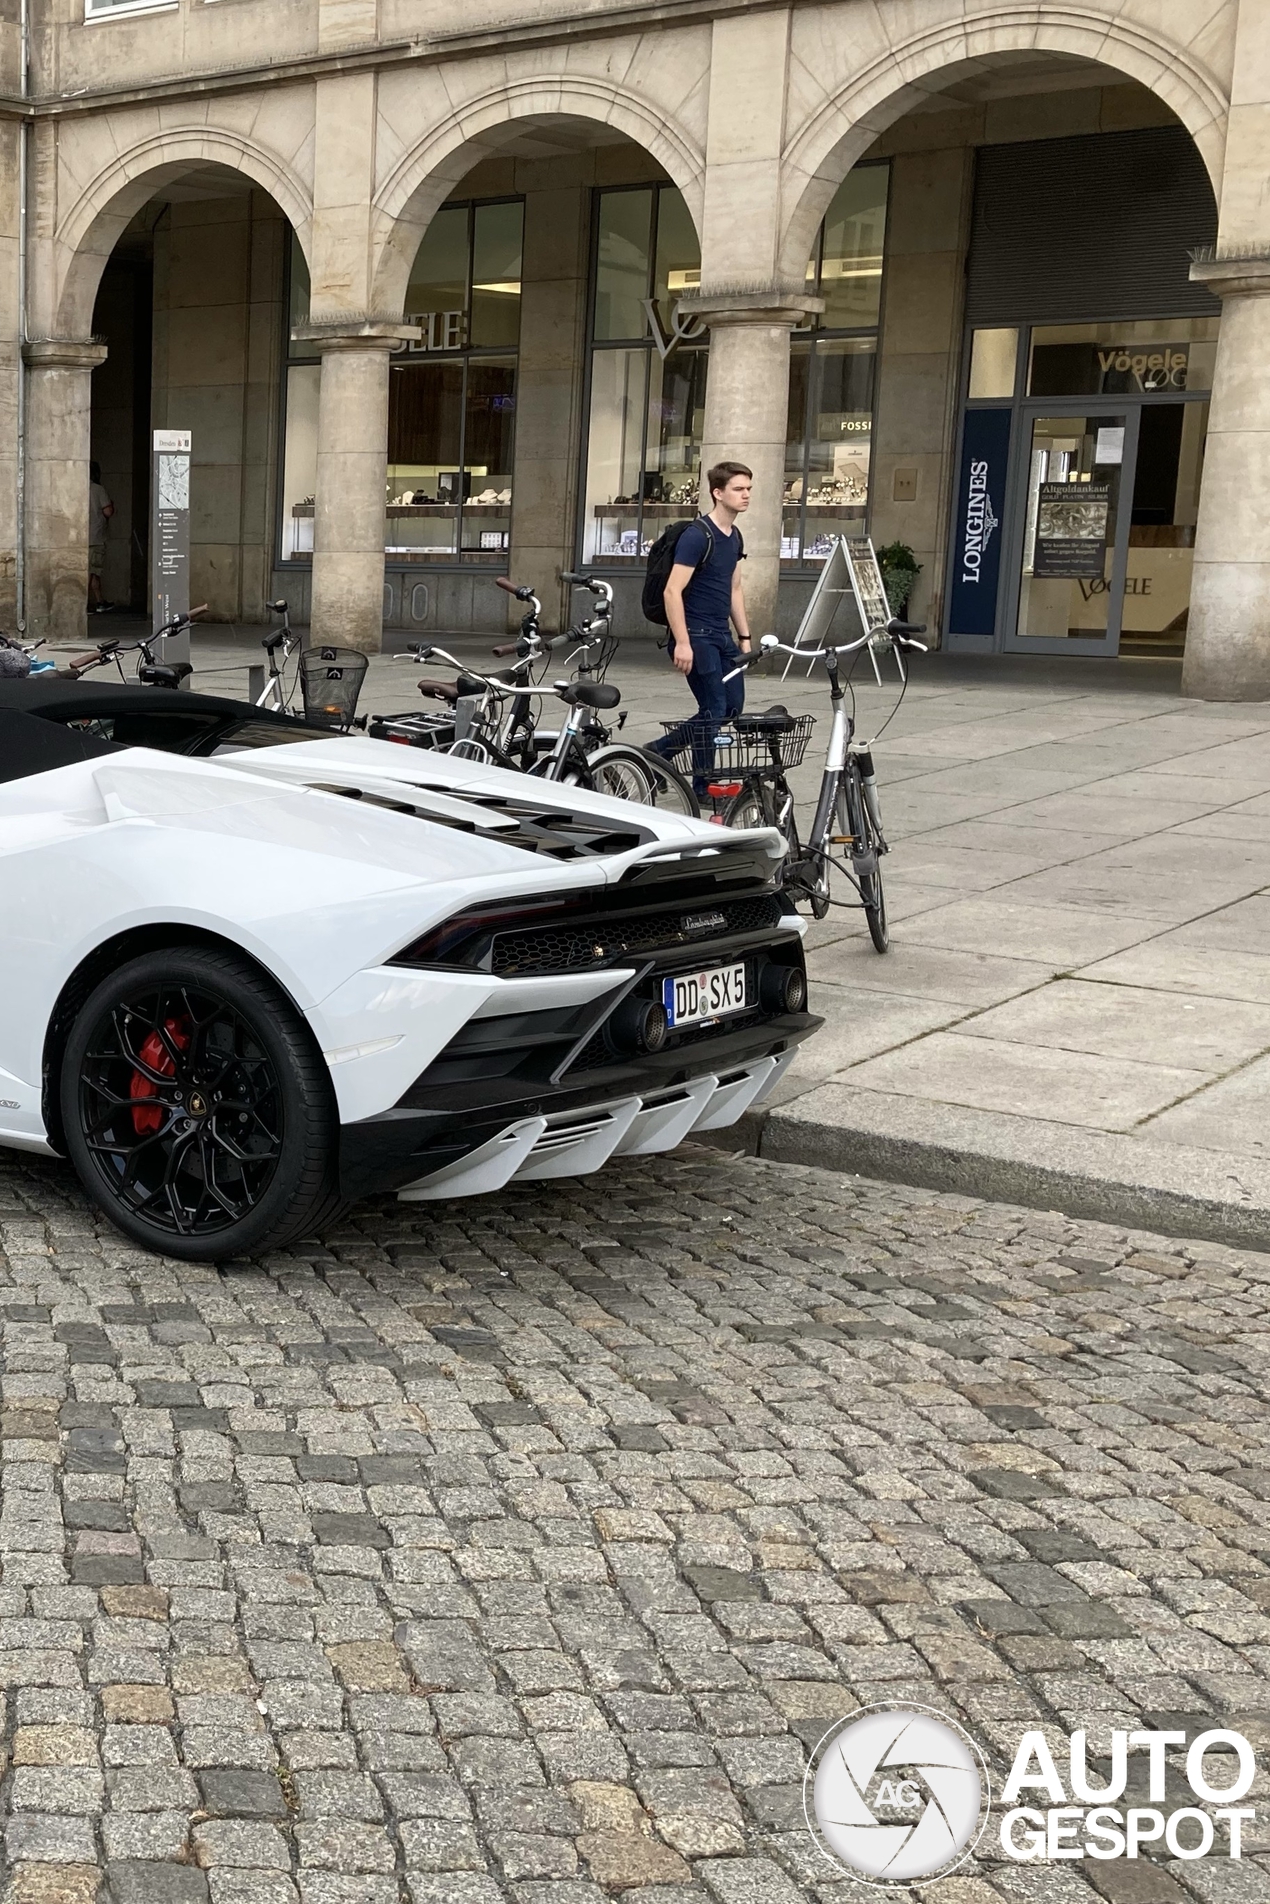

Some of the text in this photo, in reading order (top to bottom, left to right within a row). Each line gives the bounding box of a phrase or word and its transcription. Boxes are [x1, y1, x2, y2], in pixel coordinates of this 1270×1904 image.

[1098, 349, 1186, 374] Vögele
[1042, 484, 1109, 494] Altgoldankauf
[962, 461, 988, 583] LONGINES
[676, 968, 743, 1019] DD SX 5
